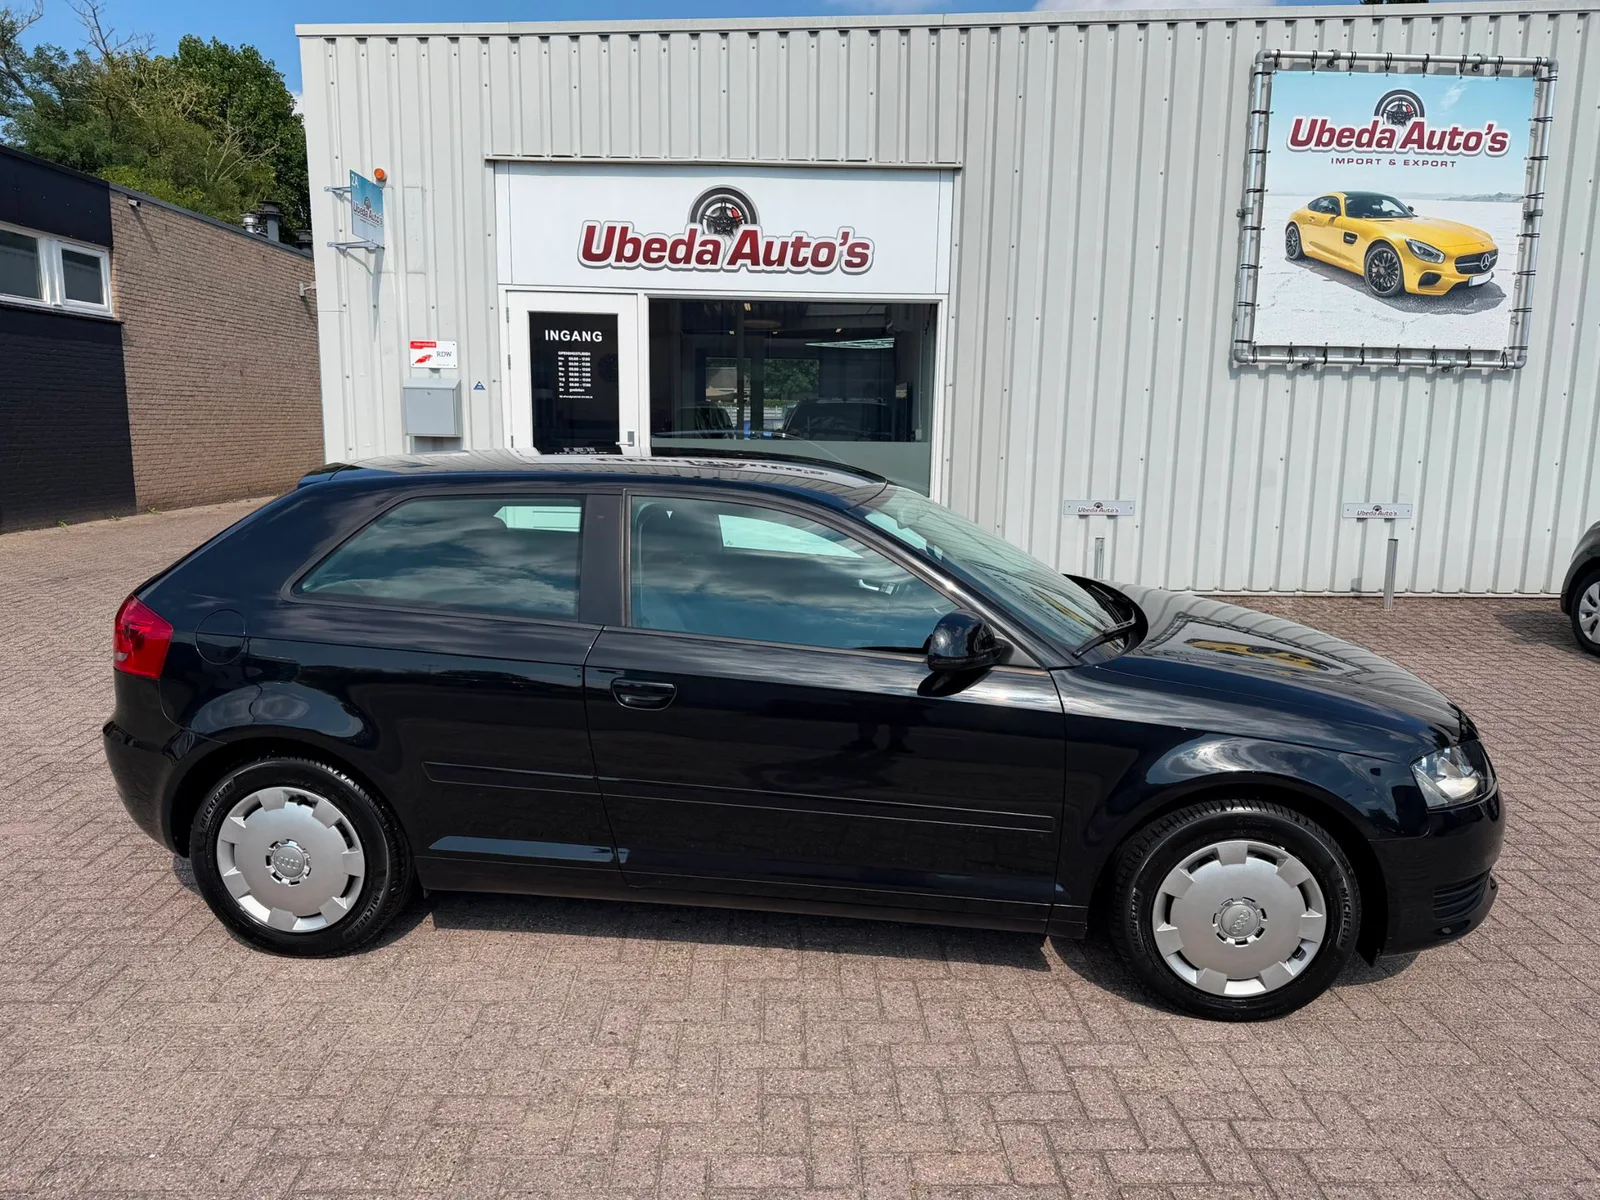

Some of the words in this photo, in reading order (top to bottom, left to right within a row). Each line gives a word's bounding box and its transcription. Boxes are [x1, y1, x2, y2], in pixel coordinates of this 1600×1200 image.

[1288, 117, 1395, 150] Ubeda
[1399, 120, 1510, 153] Auto's
[1330, 157, 1382, 166] IMPORT
[1387, 158, 1397, 167] &
[1402, 159, 1457, 168] EXPORT
[580, 223, 724, 266] Ubeda
[725, 227, 873, 270] Auto's
[436, 350, 453, 358] RDW
[544, 329, 603, 343] INGANG
[199, 779, 234, 829] MICHELIN
[344, 894, 380, 939] MICHELIN
[1129, 890, 1143, 953] MICHELIN
[1340, 887, 1353, 949] MICHELIN
